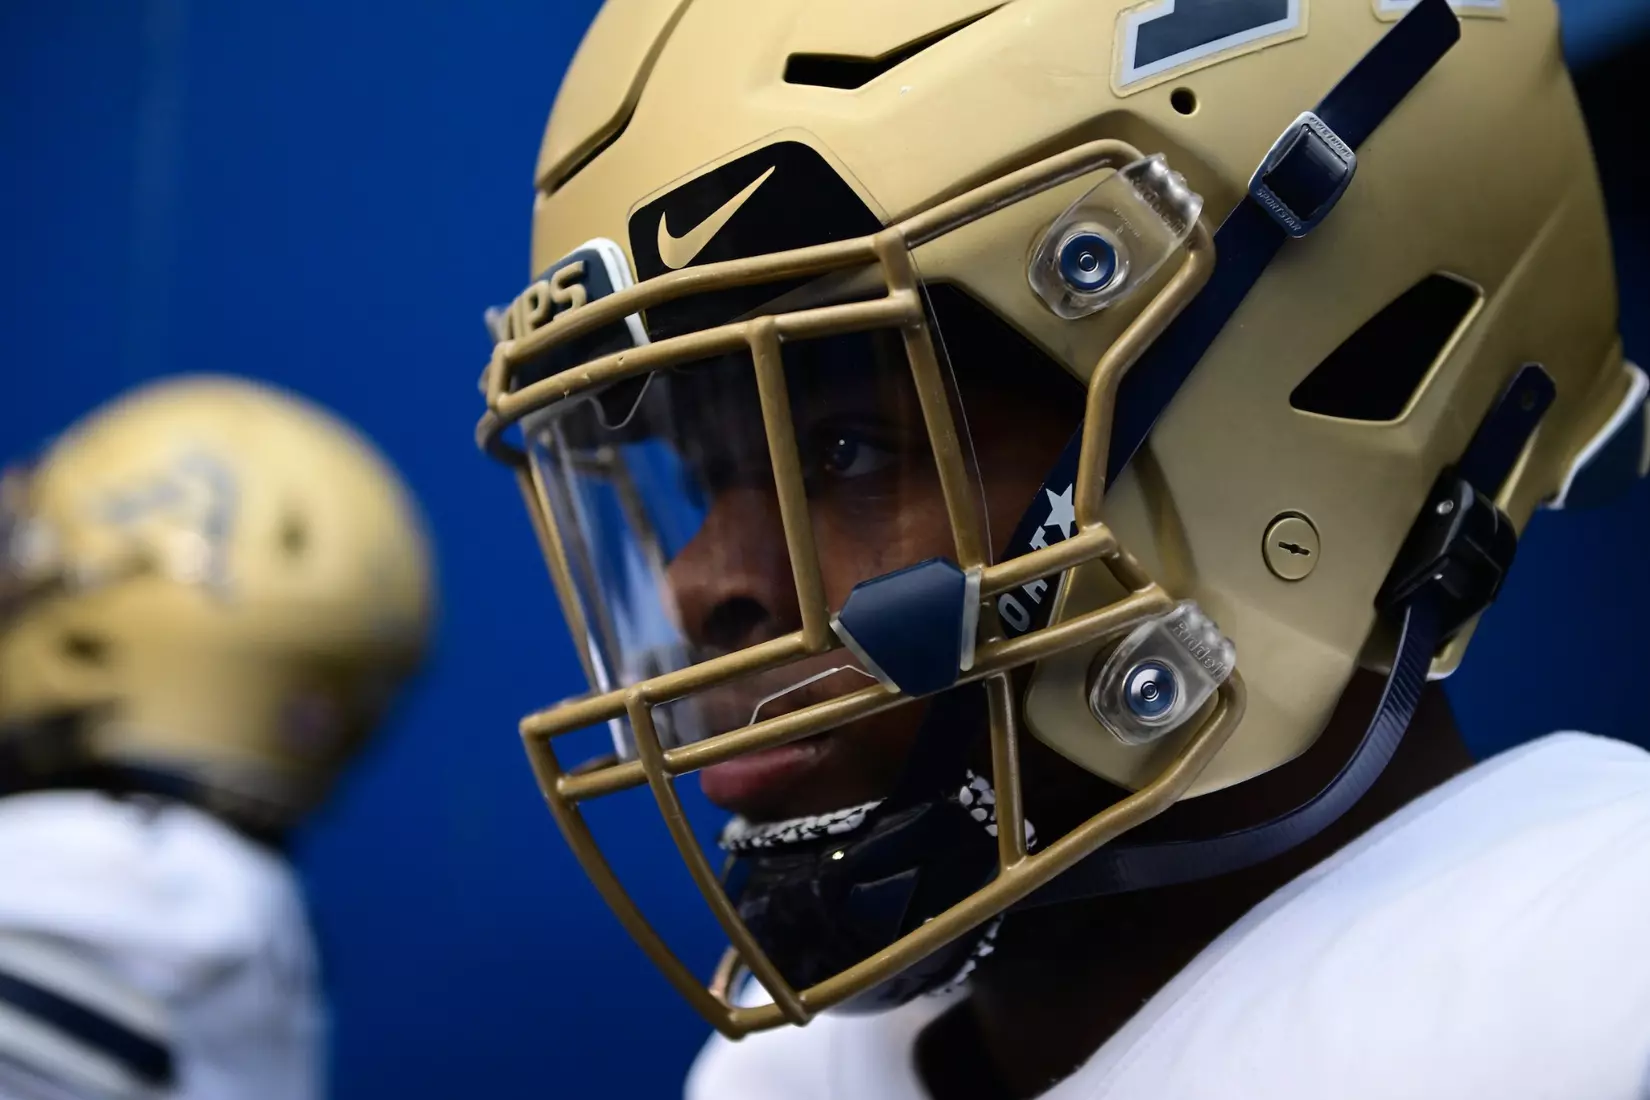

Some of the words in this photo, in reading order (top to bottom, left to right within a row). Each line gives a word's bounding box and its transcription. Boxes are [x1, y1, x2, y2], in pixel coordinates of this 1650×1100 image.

[1256, 188, 1302, 231] SPORTSTAR
[503, 260, 587, 341] IPS
[1172, 620, 1228, 683] Riddell
